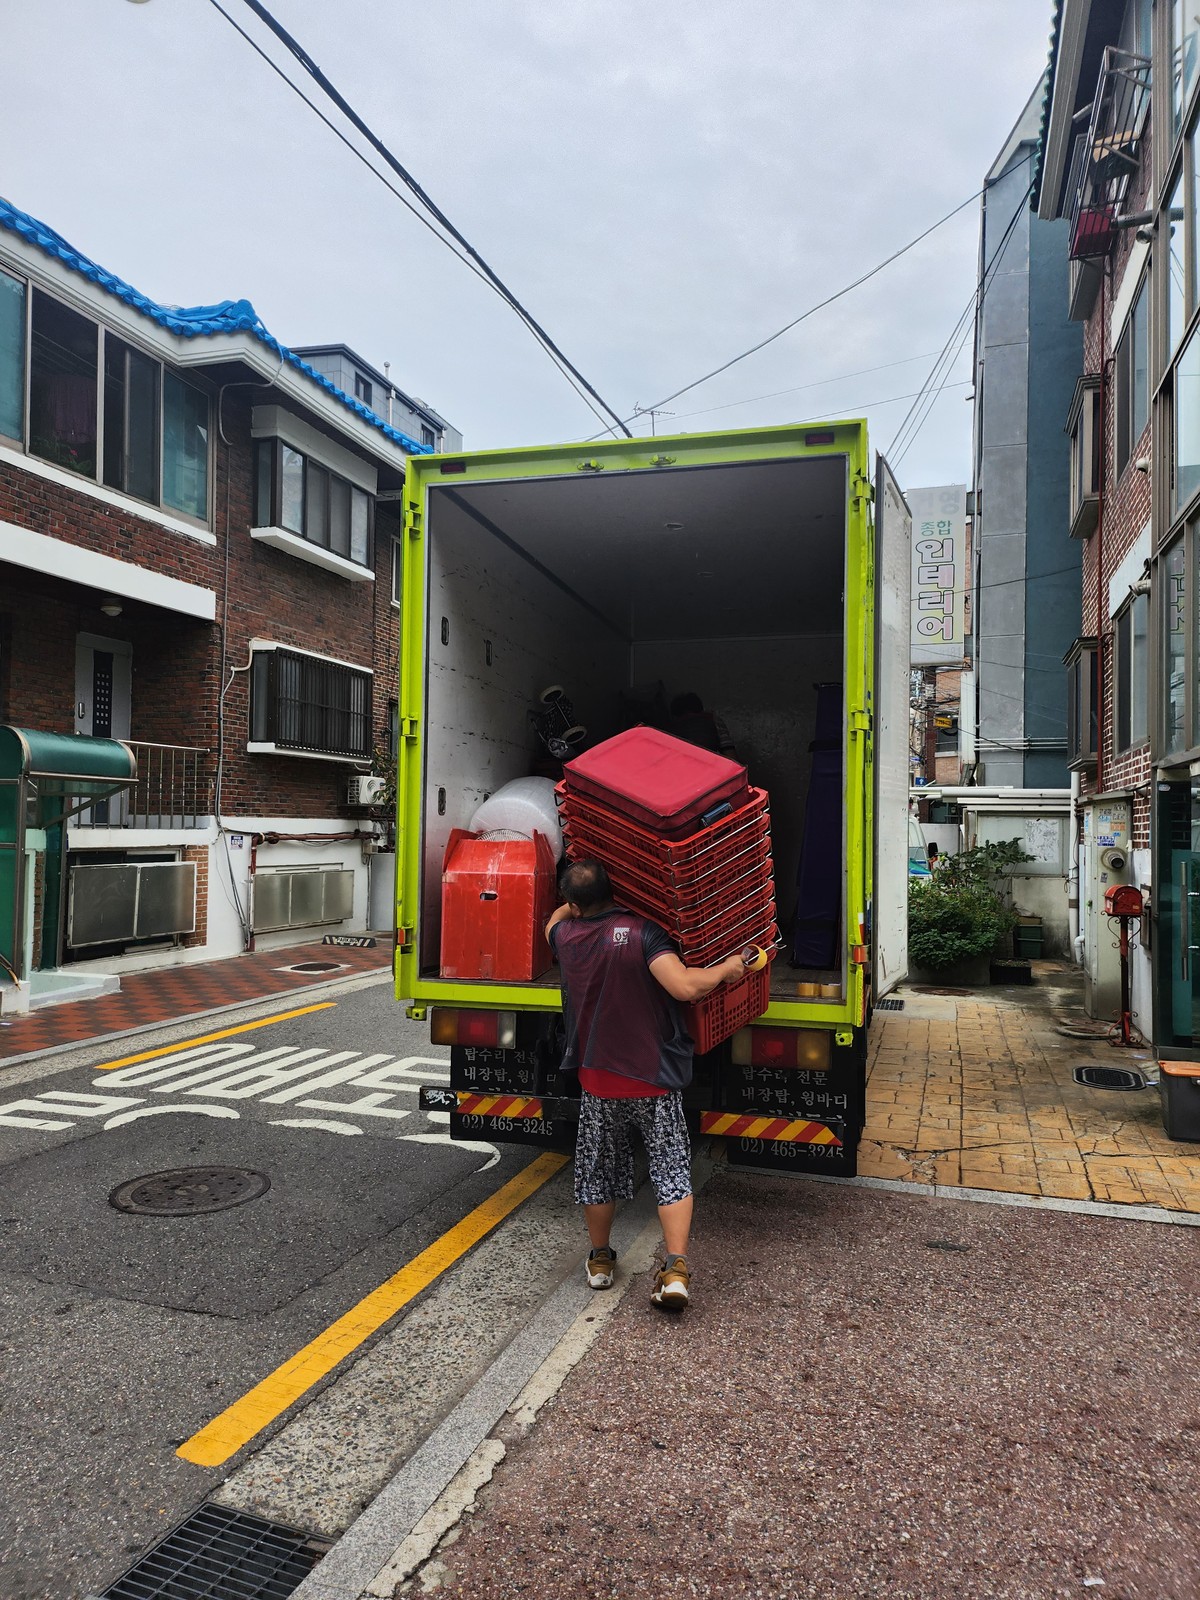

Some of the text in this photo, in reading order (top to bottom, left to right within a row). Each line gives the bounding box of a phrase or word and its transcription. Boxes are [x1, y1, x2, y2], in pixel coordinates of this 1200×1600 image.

[921, 520, 953, 536] 종합
[915, 538, 955, 640] 인테리어
[464, 1046, 506, 1063] 탑수리
[463, 1065, 513, 1085] 내장탑,
[797, 1070, 829, 1086] 전문
[742, 1086, 848, 1110] 내장탑, 윙바디
[461, 1113, 553, 1136] 02) 465-3245
[740, 1137, 844, 1158] 02) 465-3245
